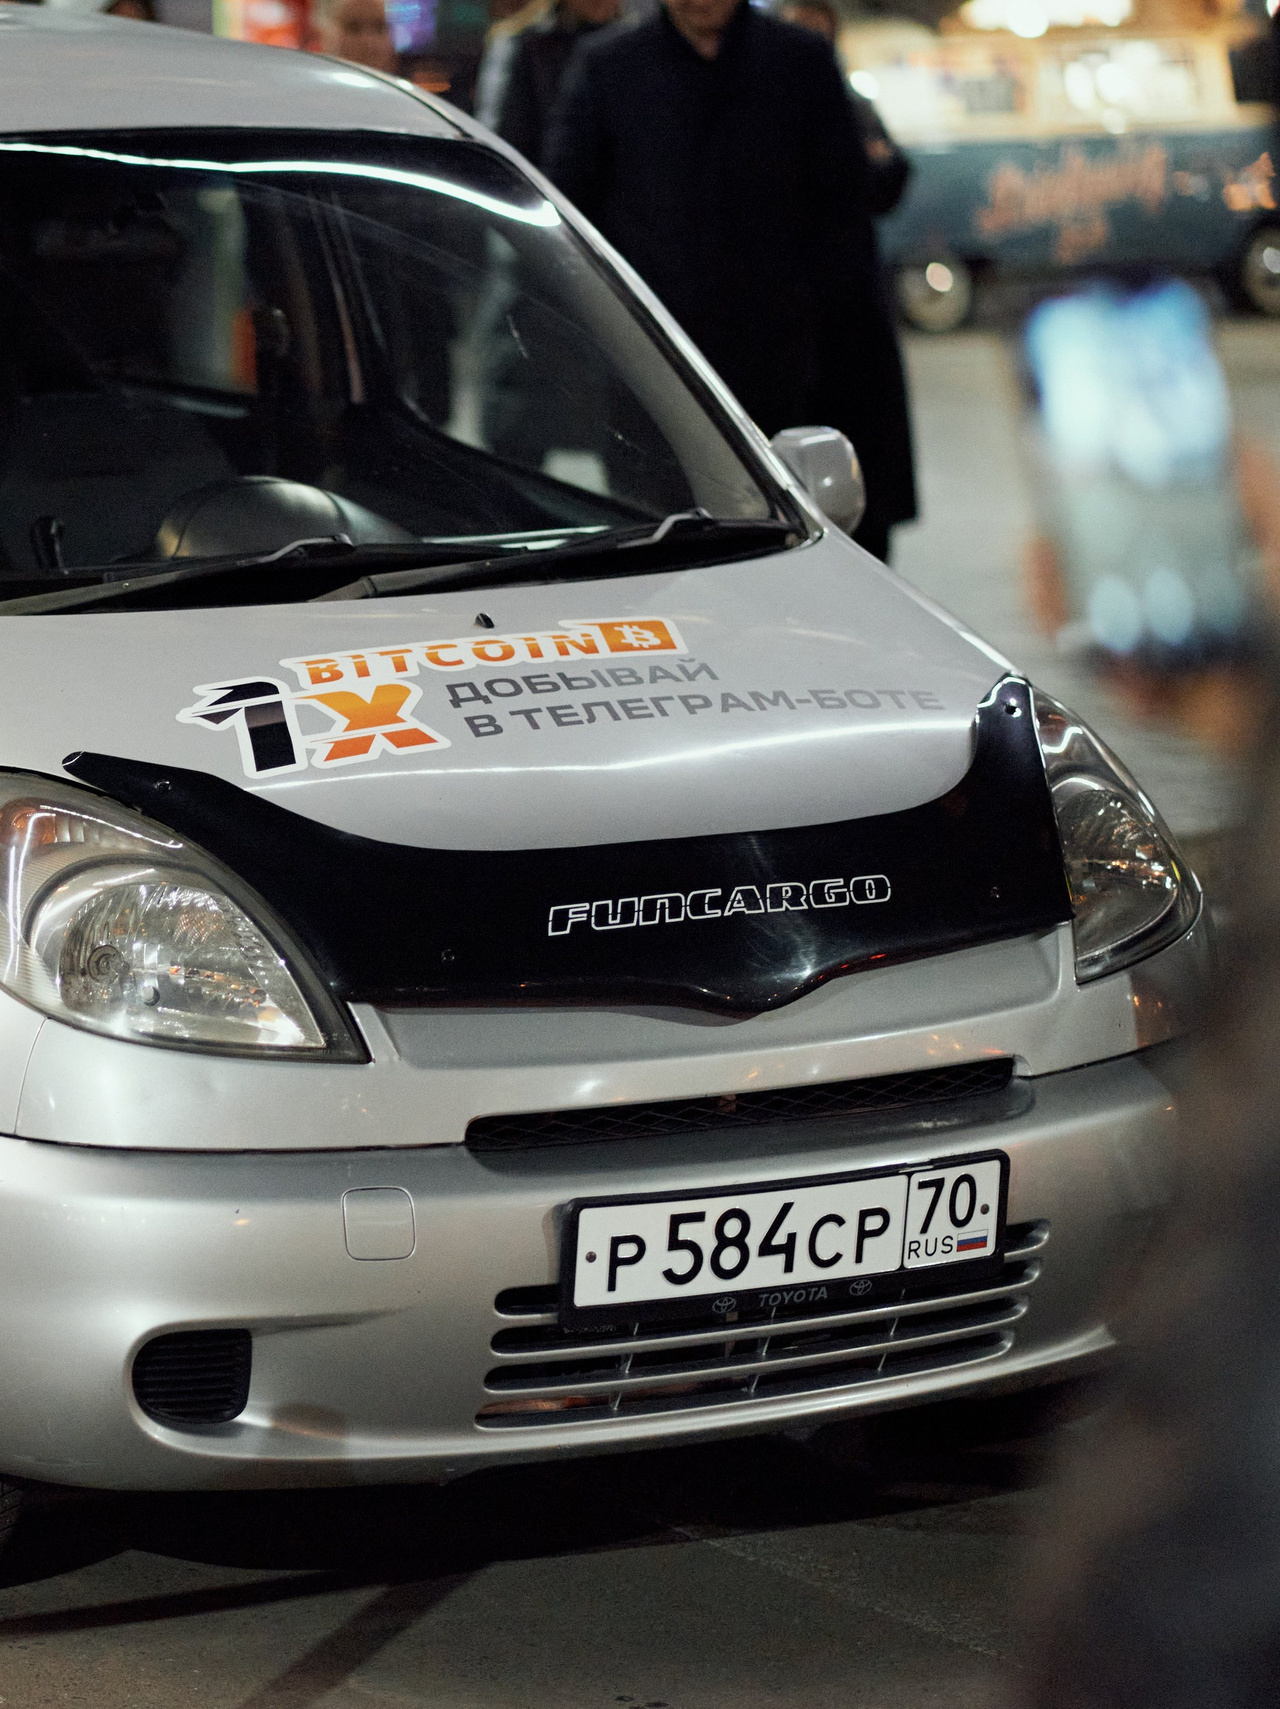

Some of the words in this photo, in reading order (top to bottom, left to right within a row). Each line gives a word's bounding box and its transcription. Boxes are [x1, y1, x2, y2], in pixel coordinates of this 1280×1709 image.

[295, 632, 601, 686] BITCOIN
[445, 657, 719, 709] ДОБЫВАЙ
[464, 714, 504, 739] В
[507, 688, 946, 731] ТЕЛЕГРАМ-БОТЕ
[548, 874, 892, 936] FUNCARGO
[917, 1173, 978, 1234] 70
[908, 1236, 954, 1260] RUS
[758, 1286, 828, 1308] TOYOTA
